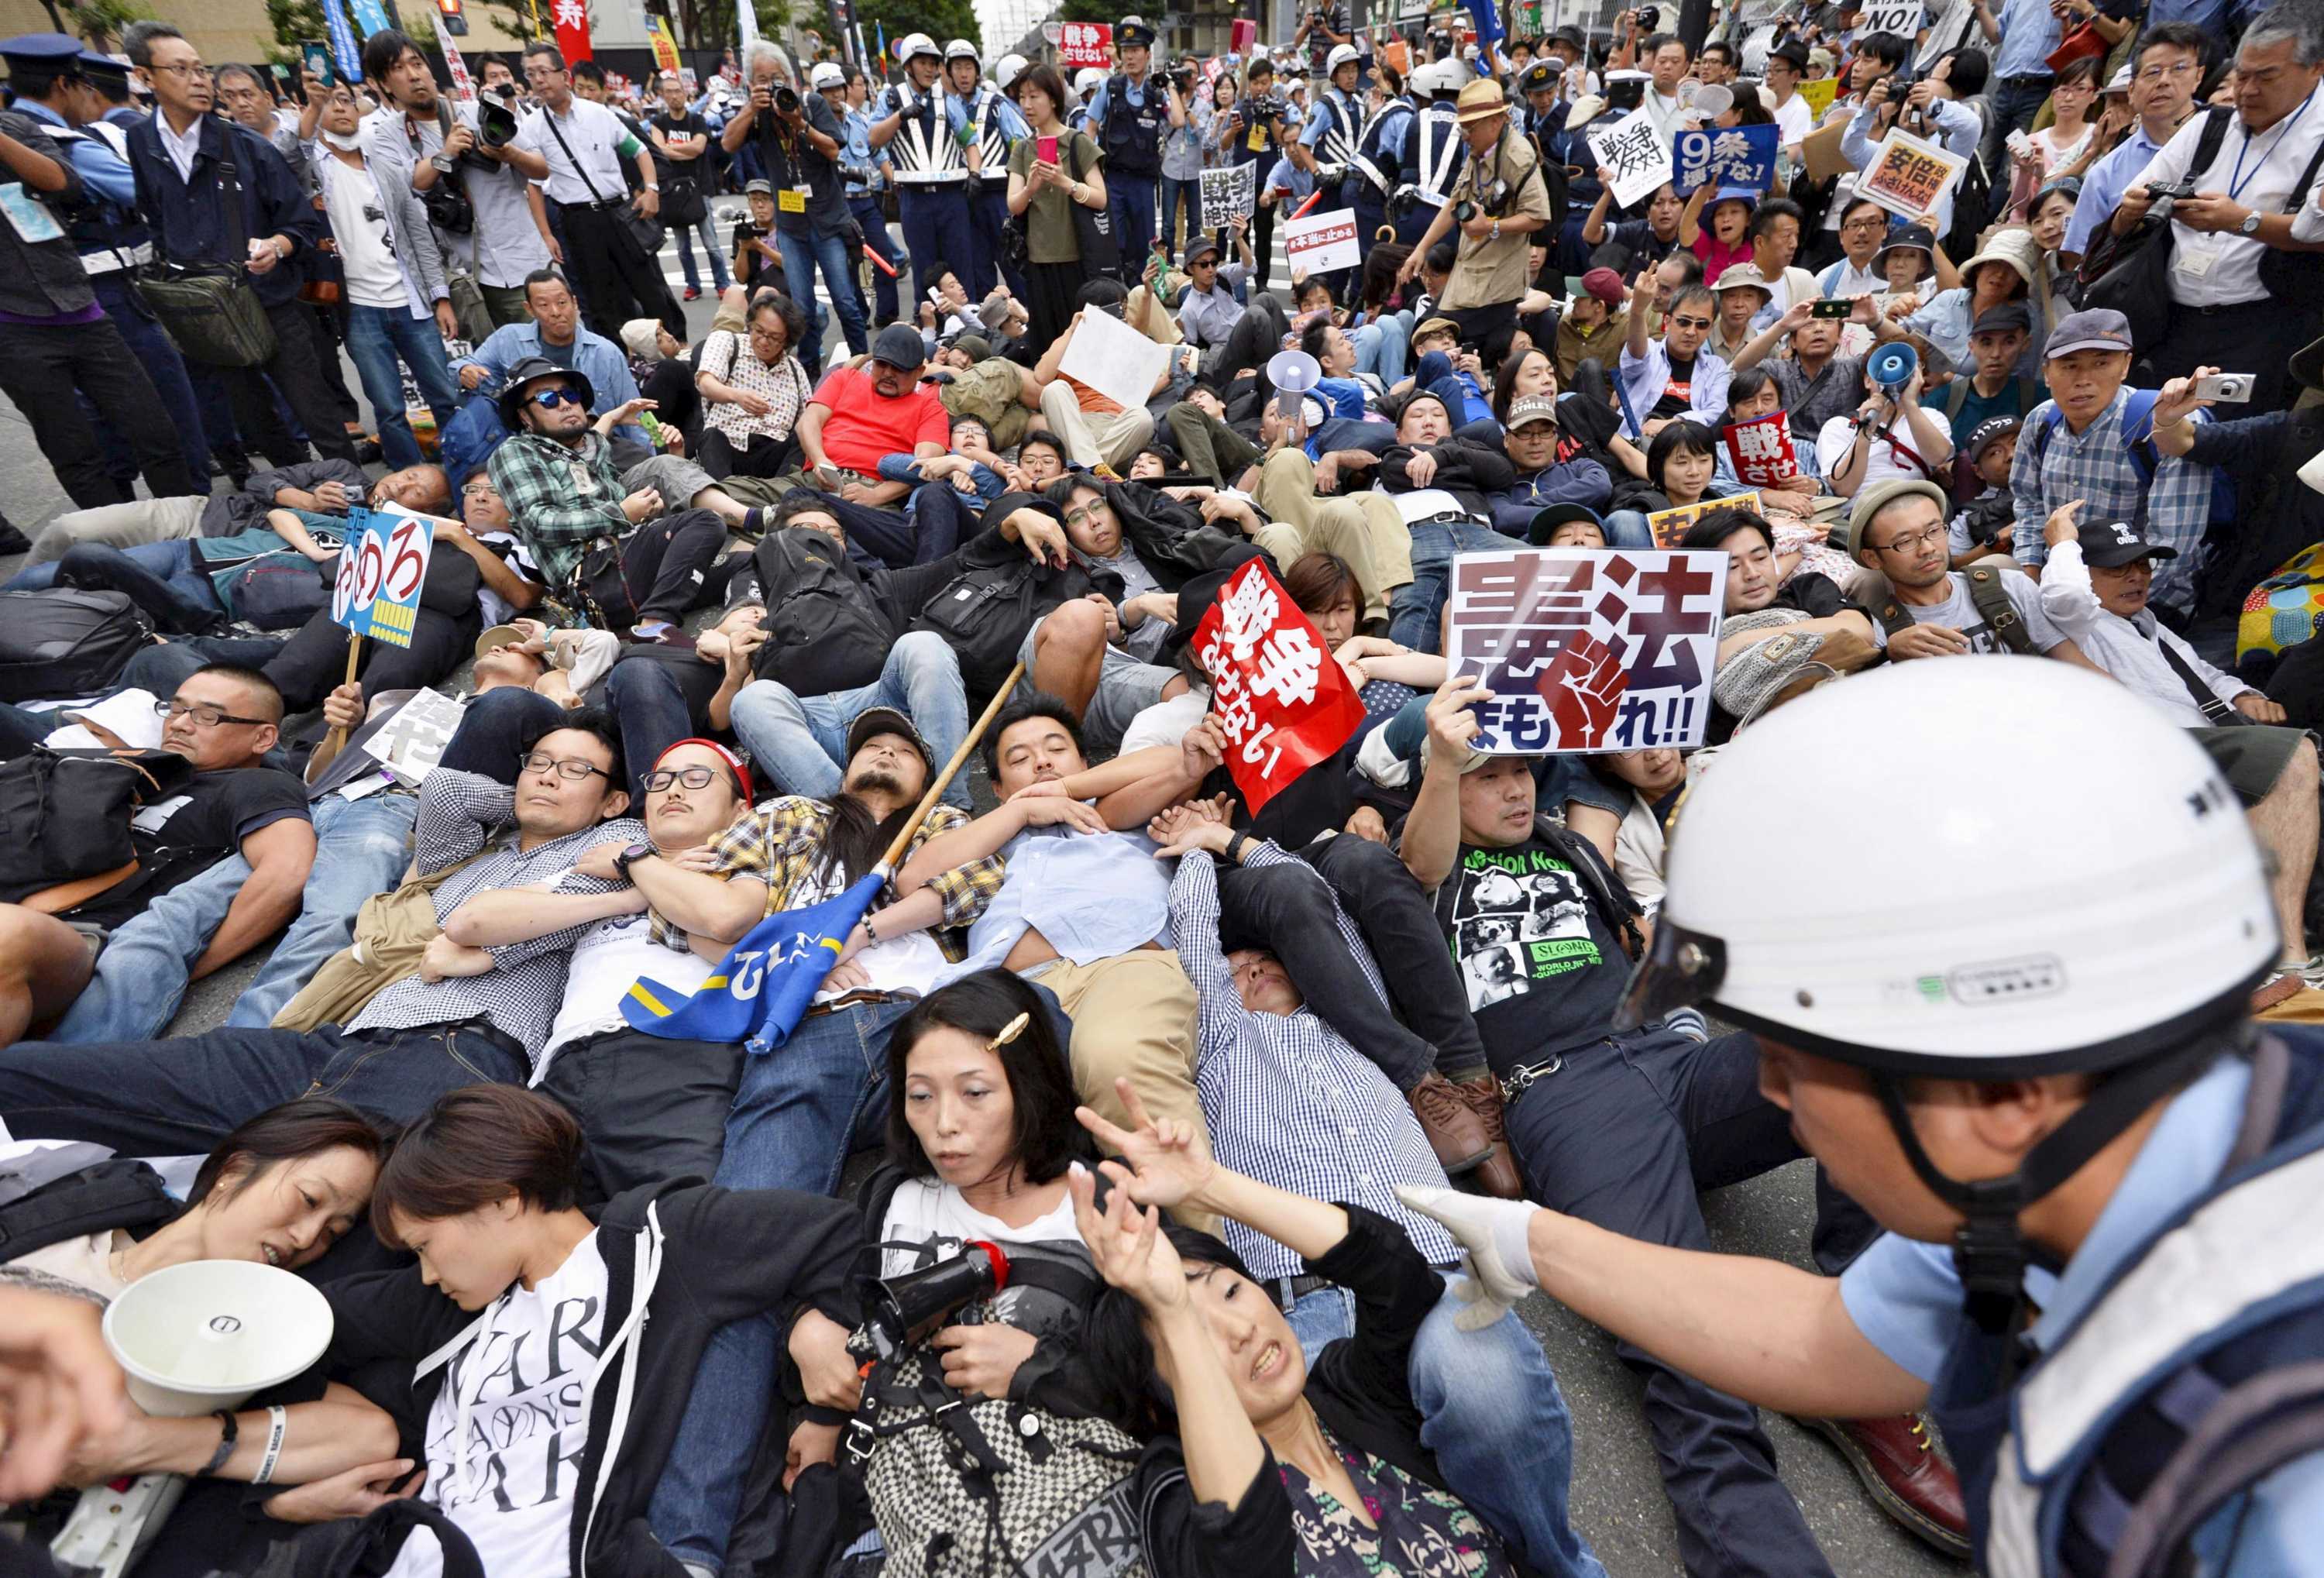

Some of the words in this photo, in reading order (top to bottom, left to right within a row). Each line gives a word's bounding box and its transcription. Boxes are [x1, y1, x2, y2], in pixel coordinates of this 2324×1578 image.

[1865, 9, 1917, 33] NO!
[1681, 132, 1751, 170] 9条
[1222, 563, 1322, 708] 戦争
[1453, 552, 1714, 694] 憲法
